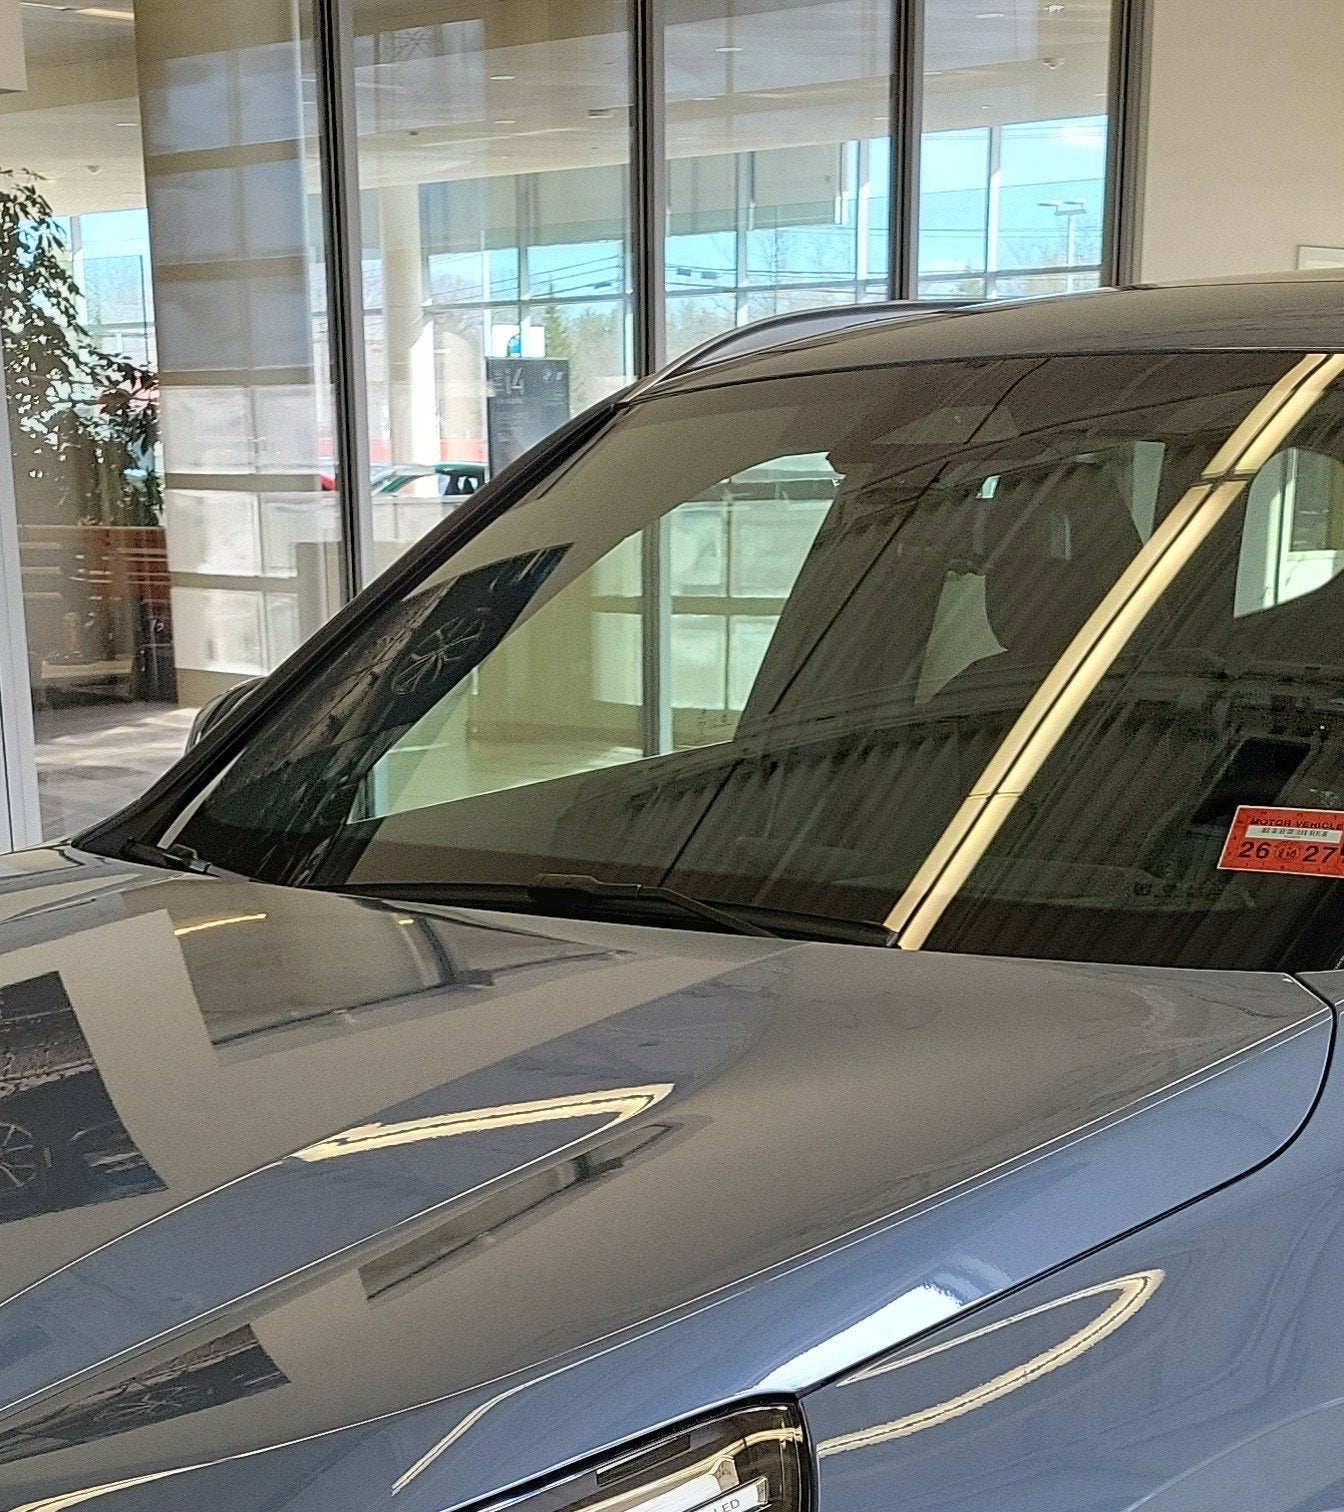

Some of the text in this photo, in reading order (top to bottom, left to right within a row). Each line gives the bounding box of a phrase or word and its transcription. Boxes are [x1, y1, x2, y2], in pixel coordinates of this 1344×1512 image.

[1249, 817, 1344, 830] MOTOR VEHICLE
[1238, 841, 1272, 860] 26
[1302, 845, 1339, 864] 27
